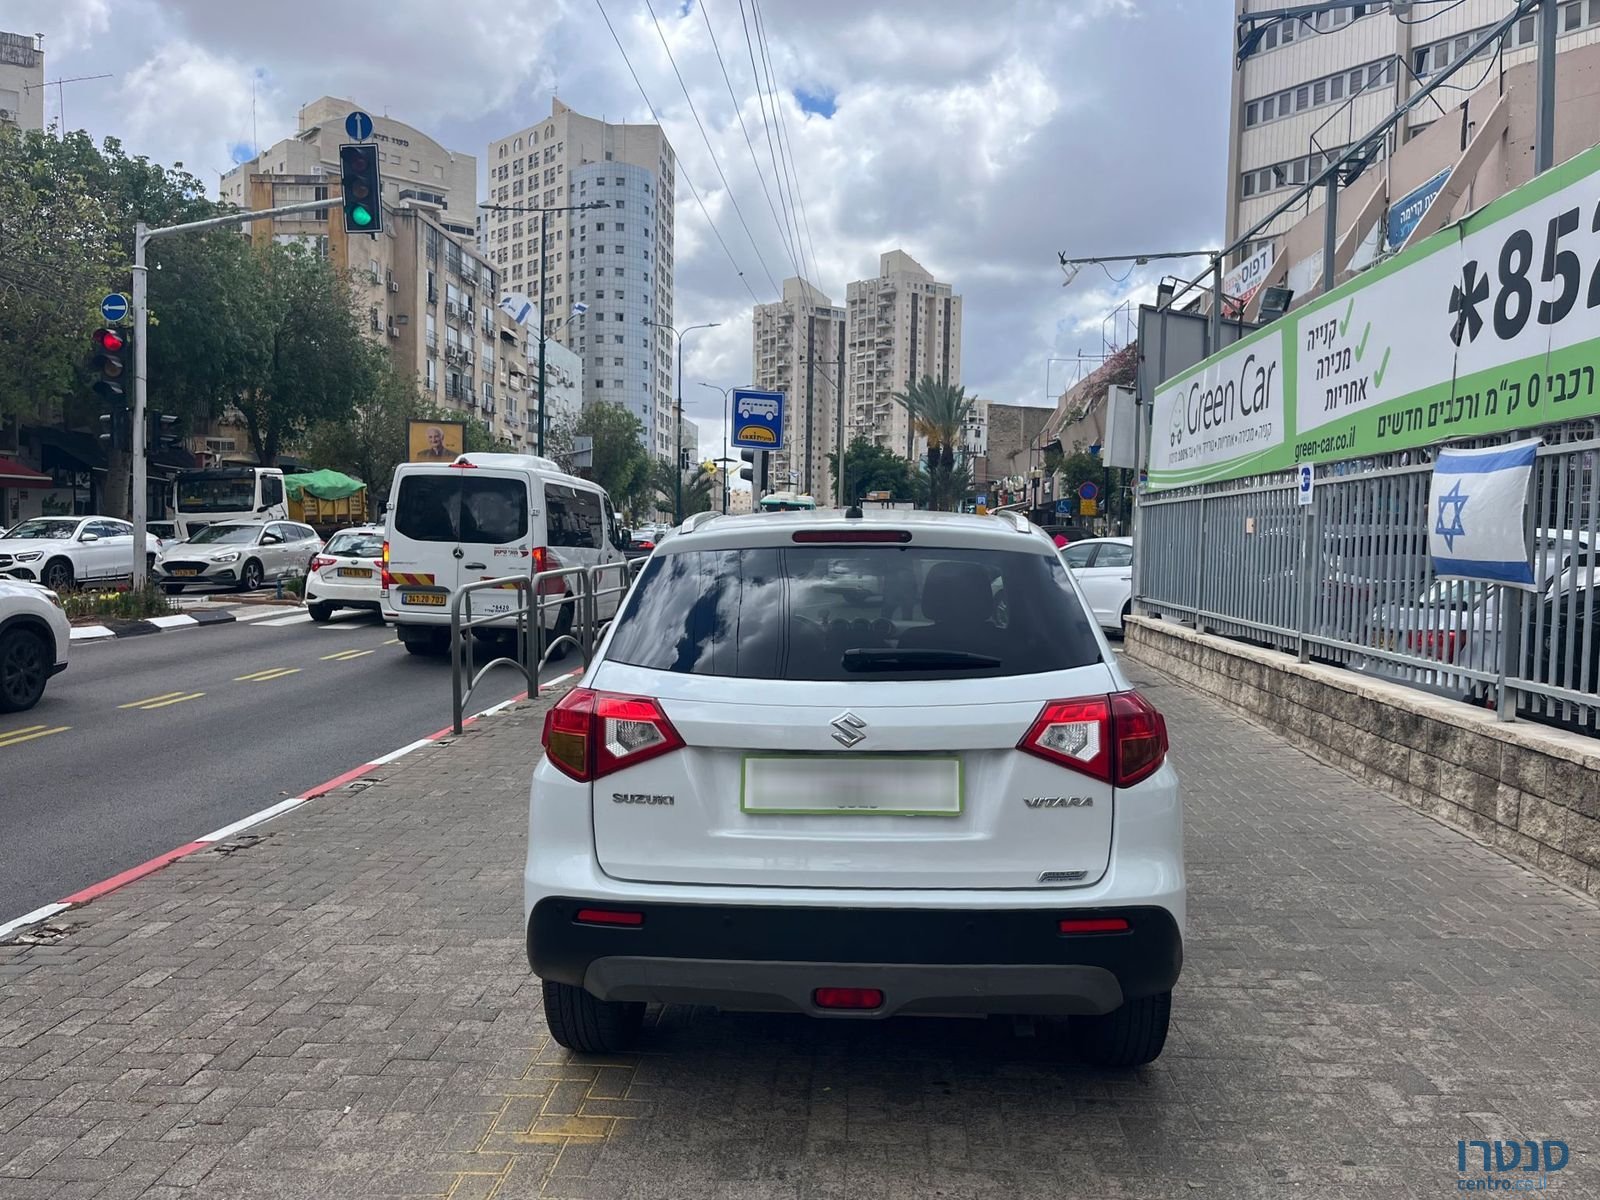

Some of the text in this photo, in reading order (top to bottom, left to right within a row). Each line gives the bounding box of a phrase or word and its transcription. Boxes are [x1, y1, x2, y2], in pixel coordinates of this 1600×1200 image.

[1400, 199, 1423, 224] קדימה
[1241, 251, 1267, 283] דפוס
[1307, 318, 1337, 352] קנייה
[1316, 347, 1351, 381] מכירה
[1187, 354, 1276, 435] Green Car
[1324, 376, 1369, 412] אחריות
[1527, 373, 1541, 408] 0
[1546, 365, 1594, 404] רכבי
[1377, 405, 1423, 438] חדשים
[1427, 391, 1480, 427] ורכבים
[1294, 425, 1356, 463] green-car.co.il
[612, 793, 675, 806] SUZUKI
[1023, 796, 1094, 809] VITARA
